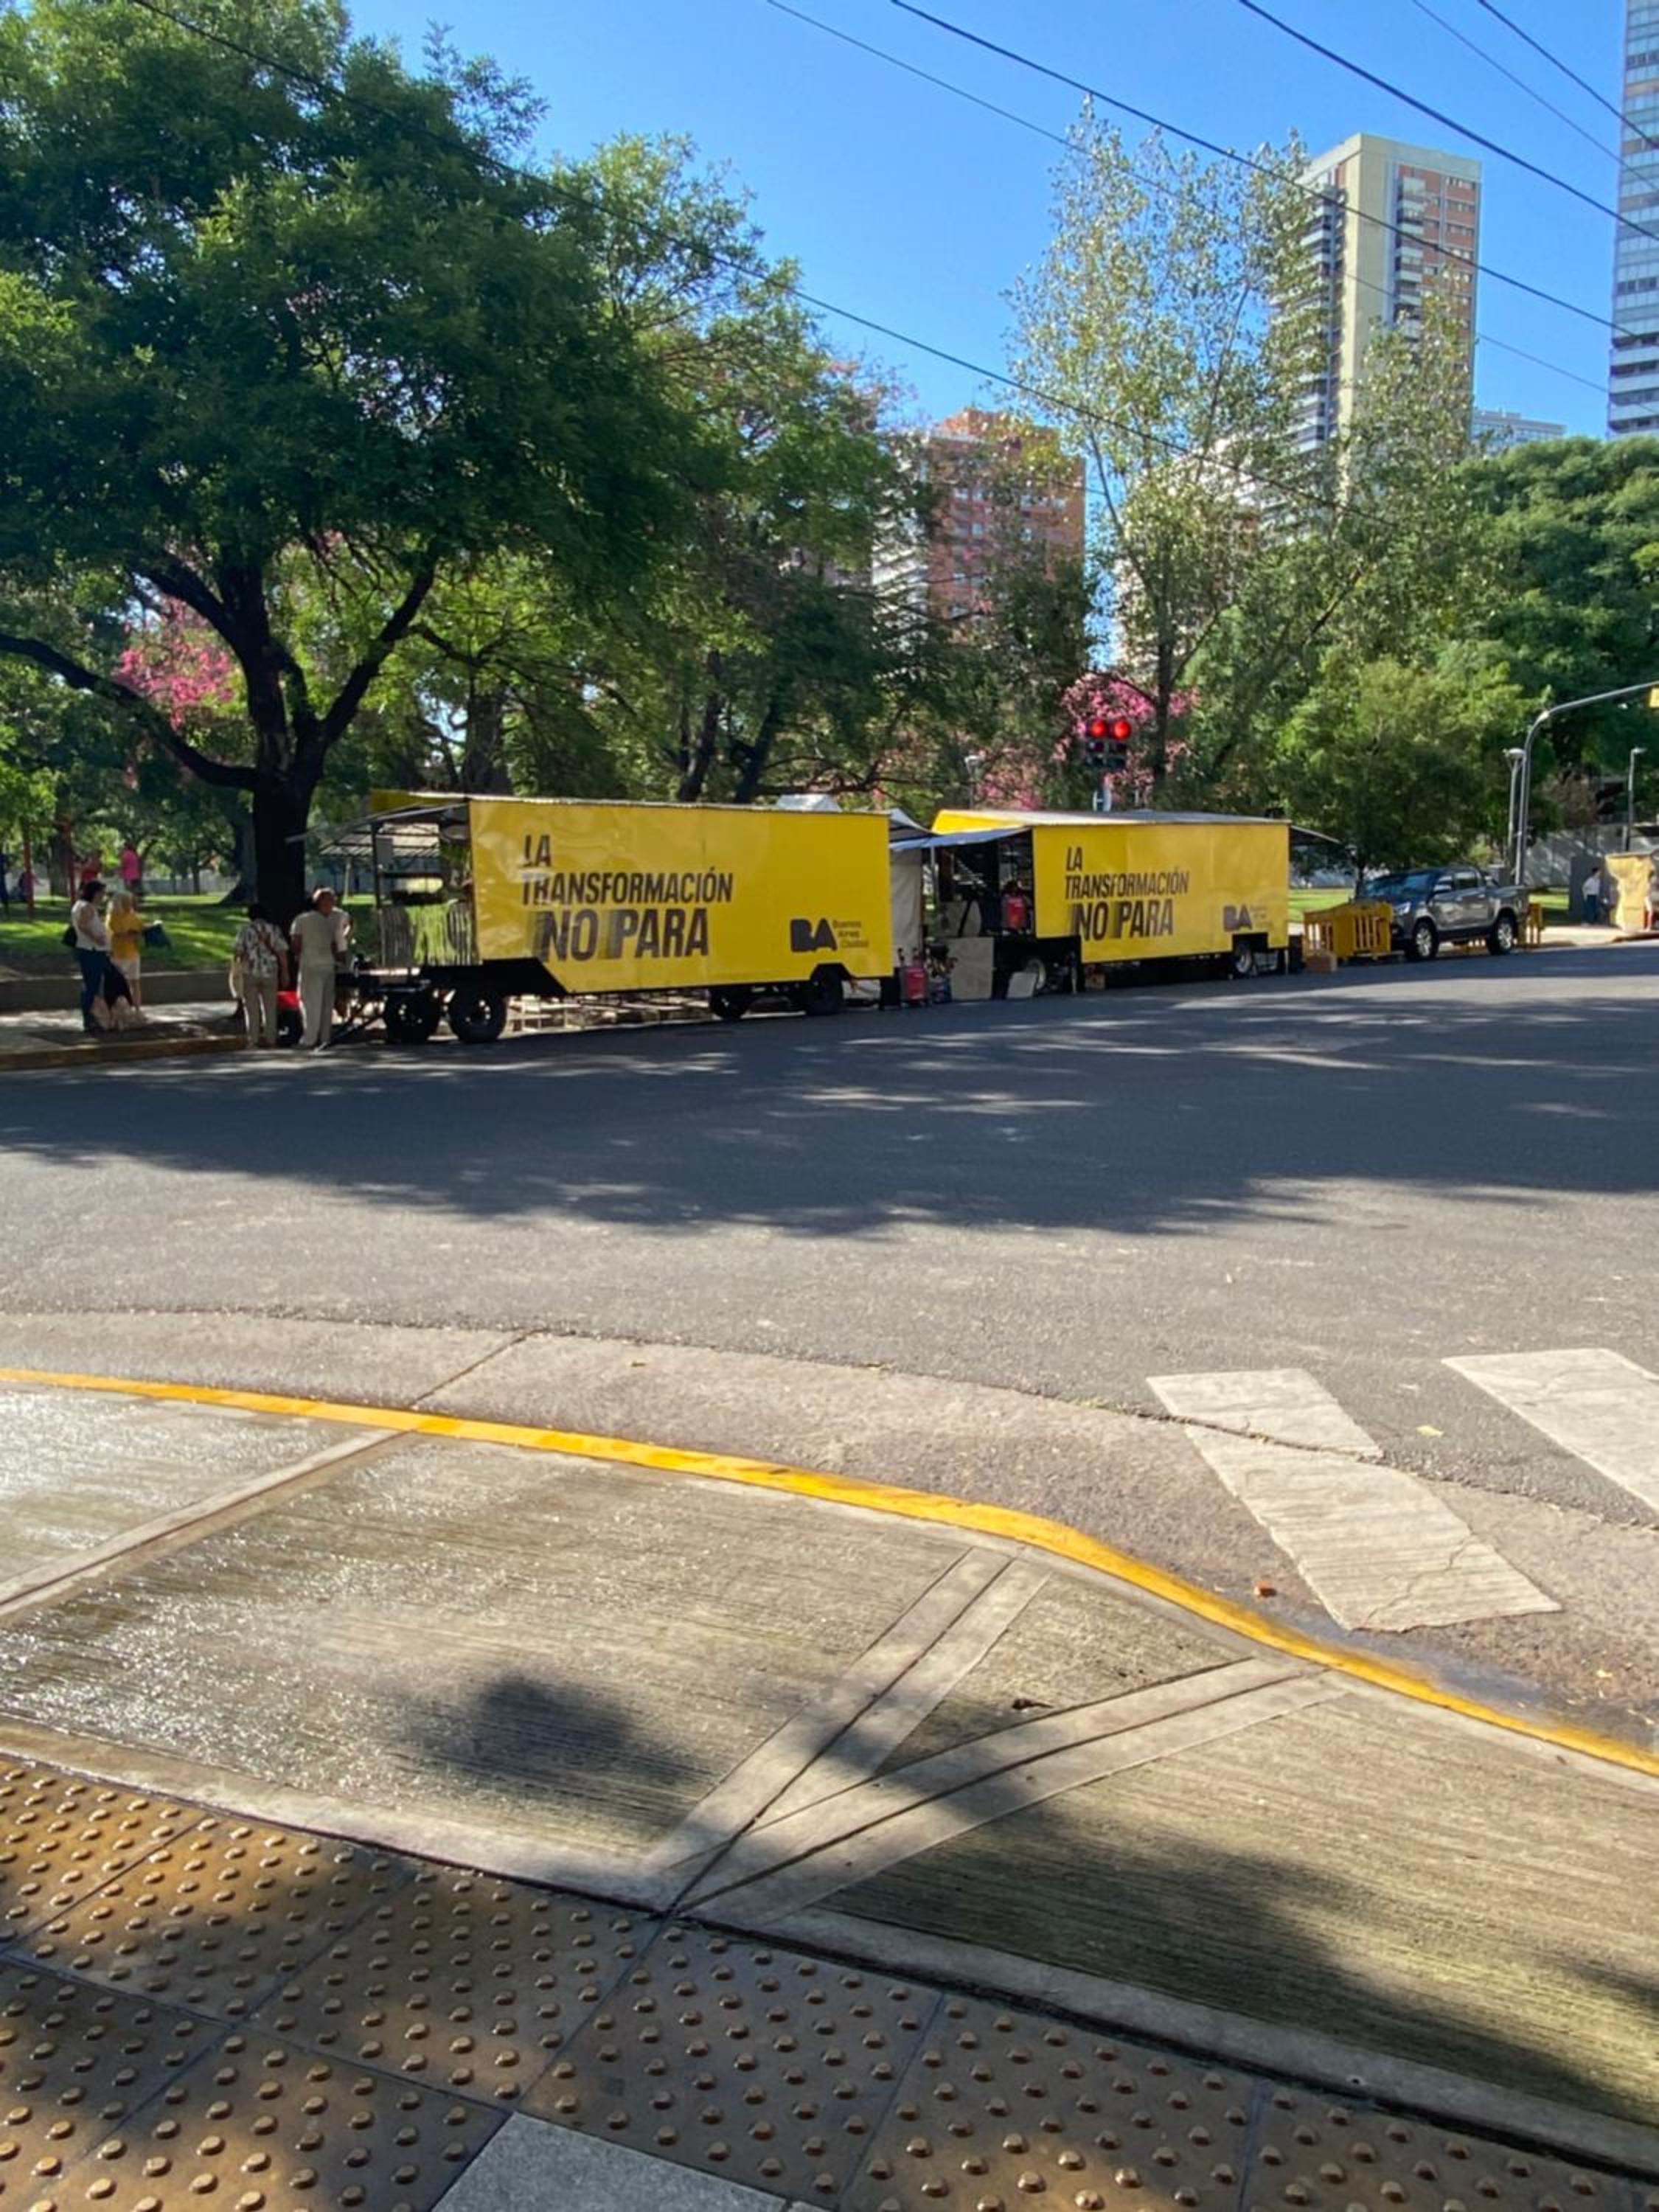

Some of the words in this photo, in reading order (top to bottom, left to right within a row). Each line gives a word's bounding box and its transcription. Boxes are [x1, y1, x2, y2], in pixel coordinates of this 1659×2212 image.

[518, 835, 552, 867] LA
[1066, 846, 1082, 872] LA
[521, 866, 734, 905] TRANSFORMACIÓN
[1065, 866, 1189, 900] TRANSFORMACIÓN
[1071, 901, 1109, 942] NO
[1110, 899, 1174, 939] PARA
[1223, 903, 1252, 932] BA
[531, 908, 599, 962] NO
[604, 908, 709, 959] PARA
[790, 918, 838, 953] BA
